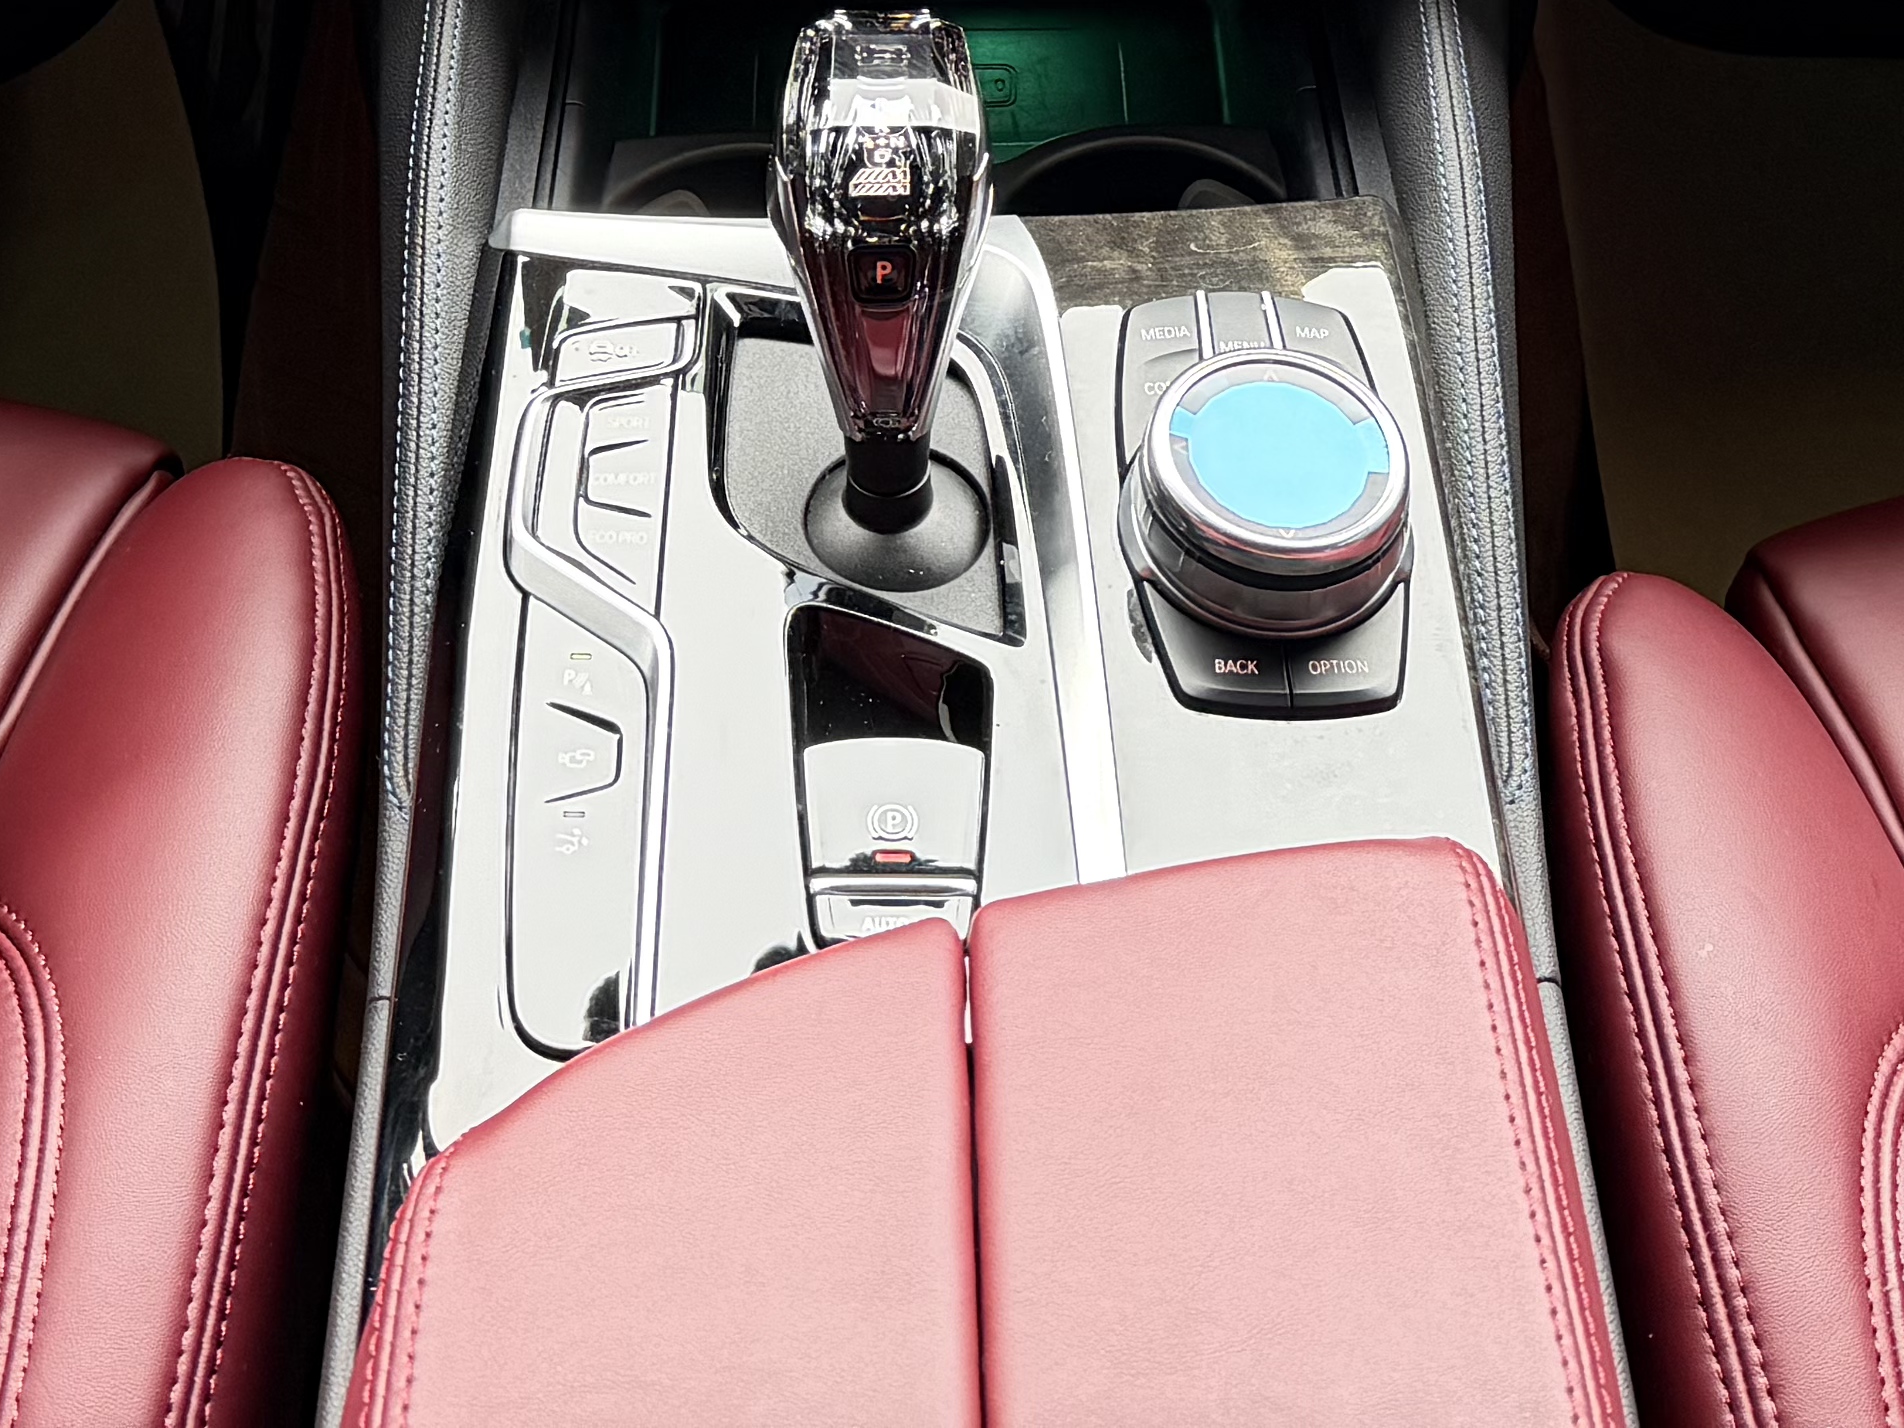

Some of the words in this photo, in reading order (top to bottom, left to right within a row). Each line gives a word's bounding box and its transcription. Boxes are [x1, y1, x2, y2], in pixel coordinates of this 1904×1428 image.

[876, 260, 893, 284] P
[1140, 326, 1191, 341] MEDIA
[1295, 326, 1330, 340] MAP
[1144, 380, 1171, 395] CO
[607, 416, 651, 430] SPORT
[591, 472, 658, 486] COMFORT
[618, 531, 648, 545] PRO
[1214, 658, 1259, 675] BACK
[1308, 659, 1370, 675] OPTION
